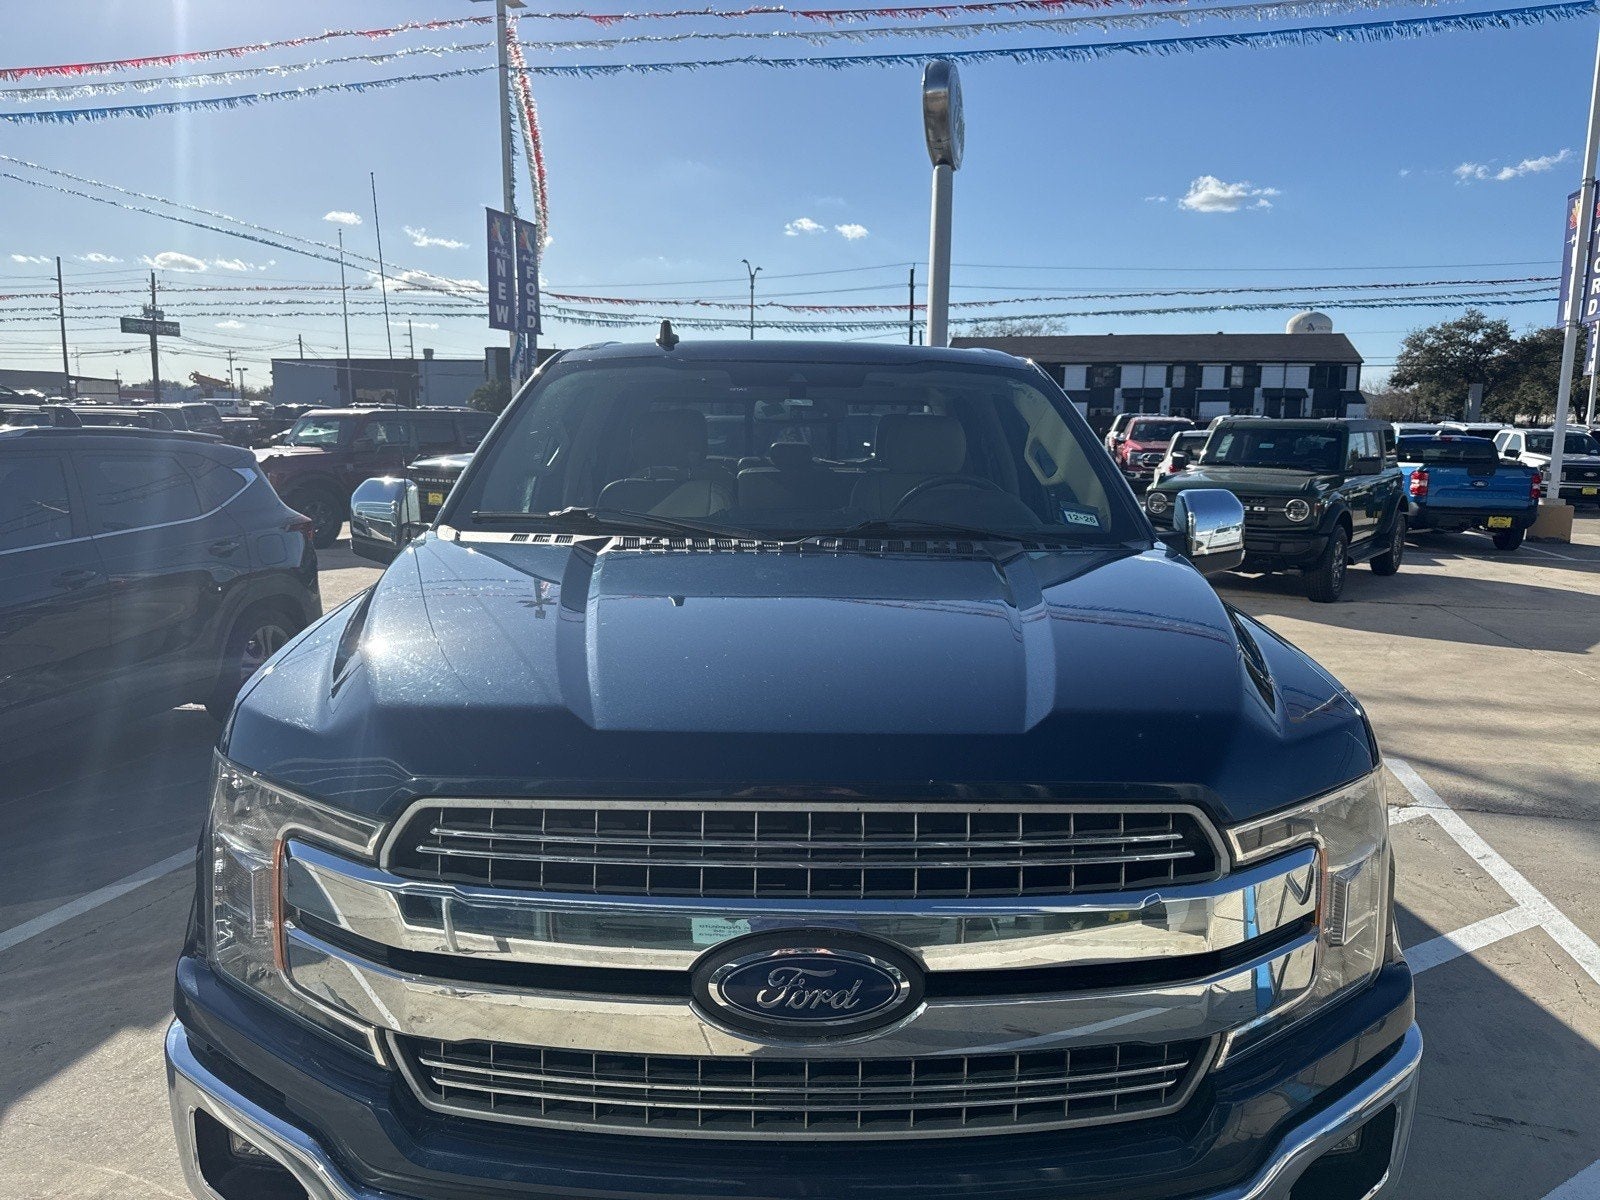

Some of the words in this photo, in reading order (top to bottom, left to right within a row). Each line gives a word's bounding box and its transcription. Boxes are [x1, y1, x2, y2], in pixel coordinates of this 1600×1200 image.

[496, 258, 508, 323] NEW
[525, 266, 536, 328] FORD
[1588, 237, 1600, 316] ORD
[756, 966, 864, 1010] Ford
